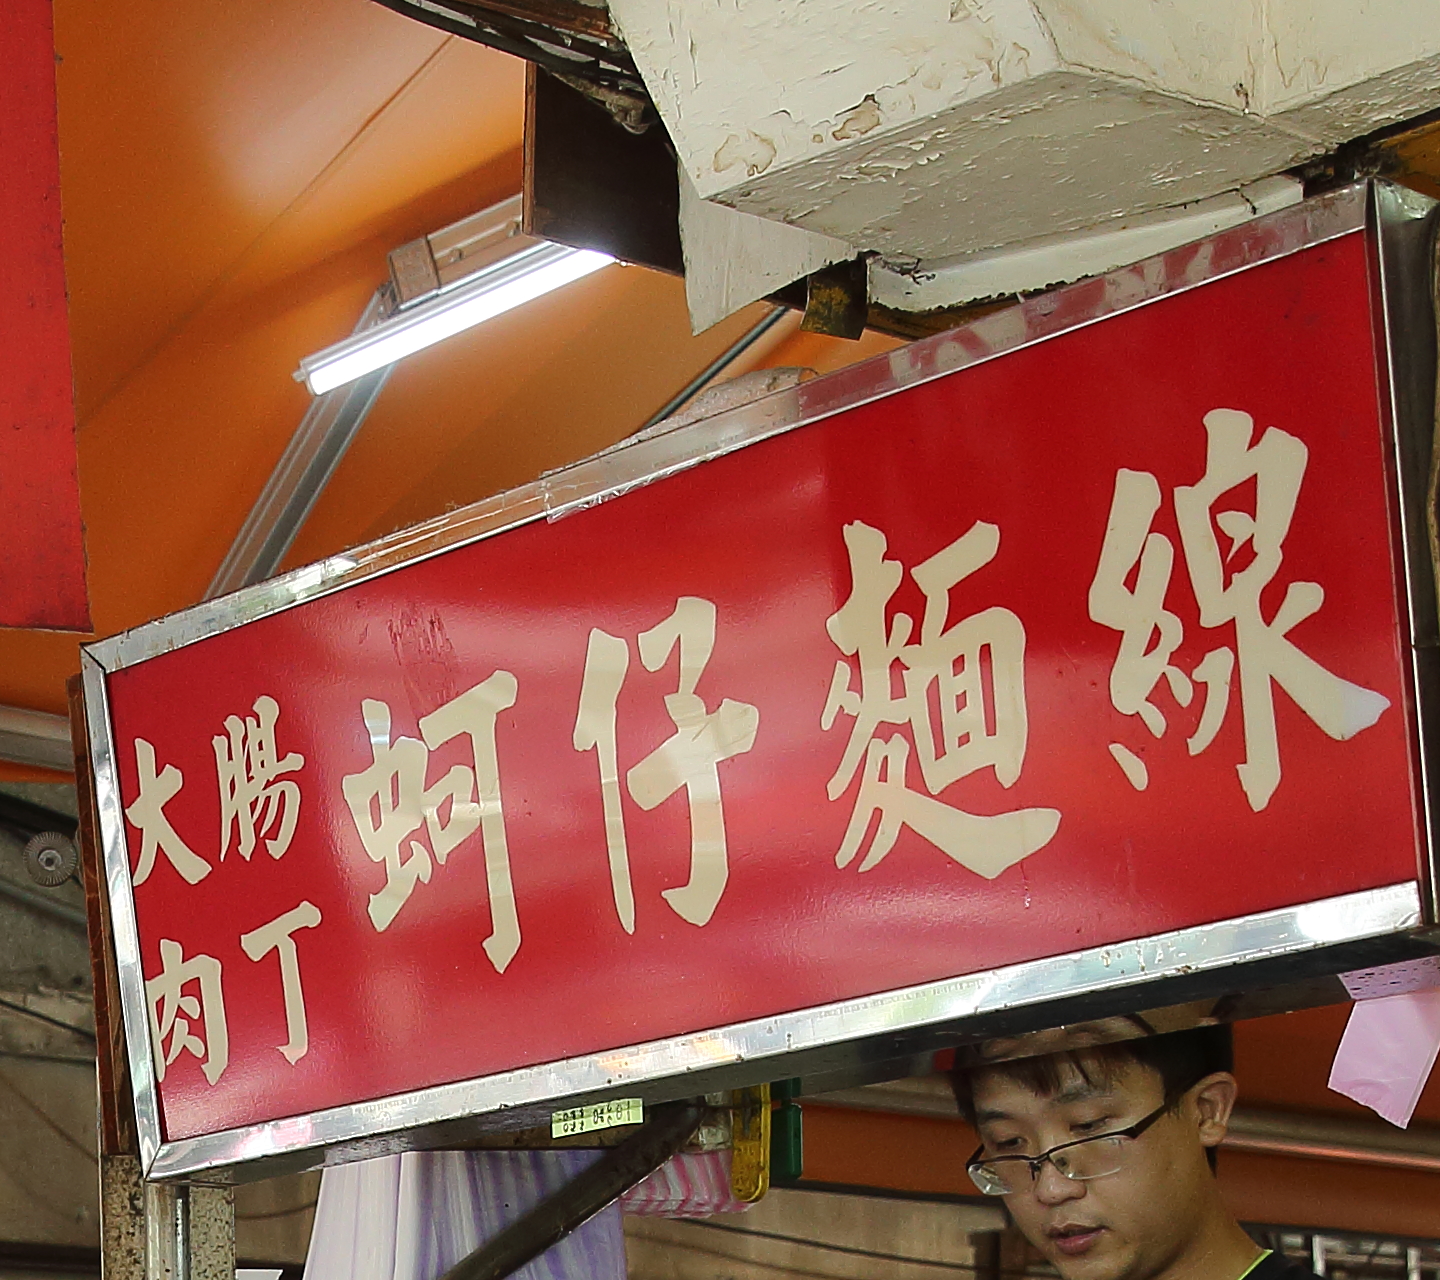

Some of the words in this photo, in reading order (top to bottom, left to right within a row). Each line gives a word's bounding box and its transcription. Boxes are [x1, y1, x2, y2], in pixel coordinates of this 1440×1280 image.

[341, 408, 1392, 974] 蚵仔麵線
[125, 695, 305, 887] 大腸
[145, 900, 322, 1086] 肉丁
